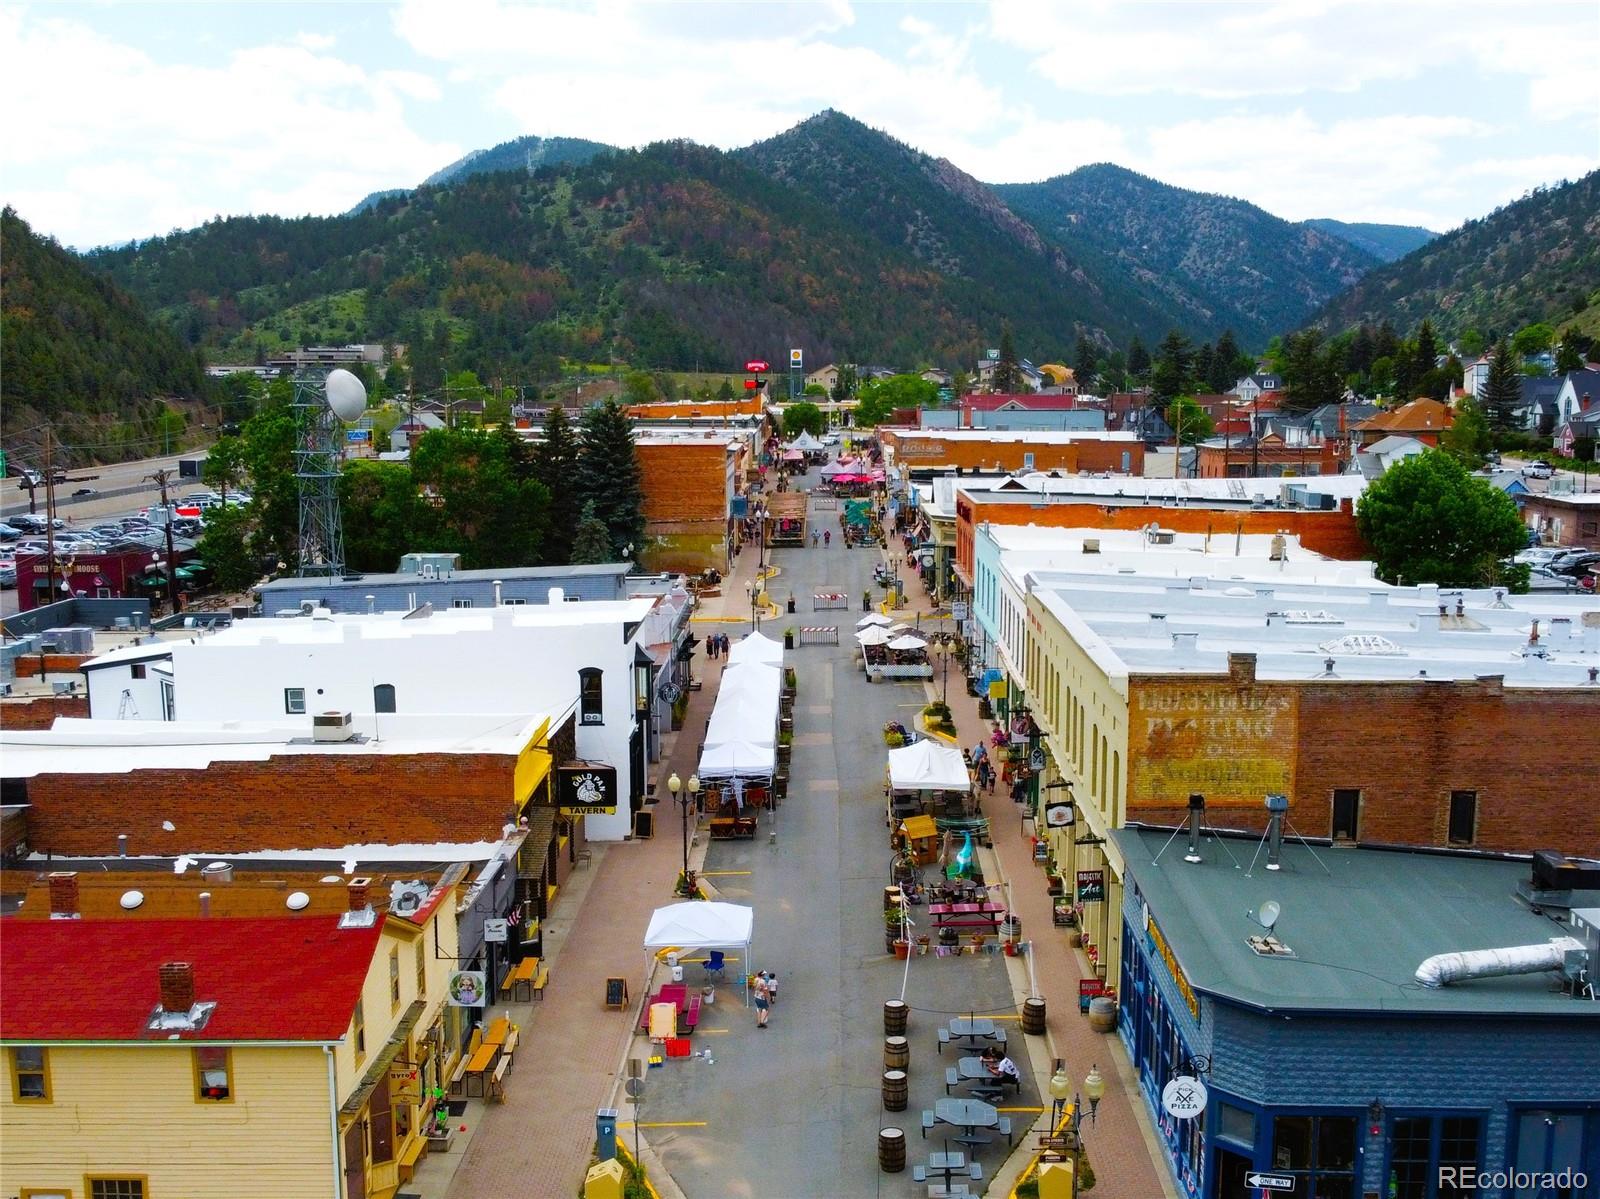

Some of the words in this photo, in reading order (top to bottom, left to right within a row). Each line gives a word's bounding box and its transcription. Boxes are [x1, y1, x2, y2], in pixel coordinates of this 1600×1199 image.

[572, 773, 592, 787] GOLD
[594, 776, 606, 791] PAN
[1081, 883, 1100, 895] Art
[1260, 1177, 1273, 1185] ONE
